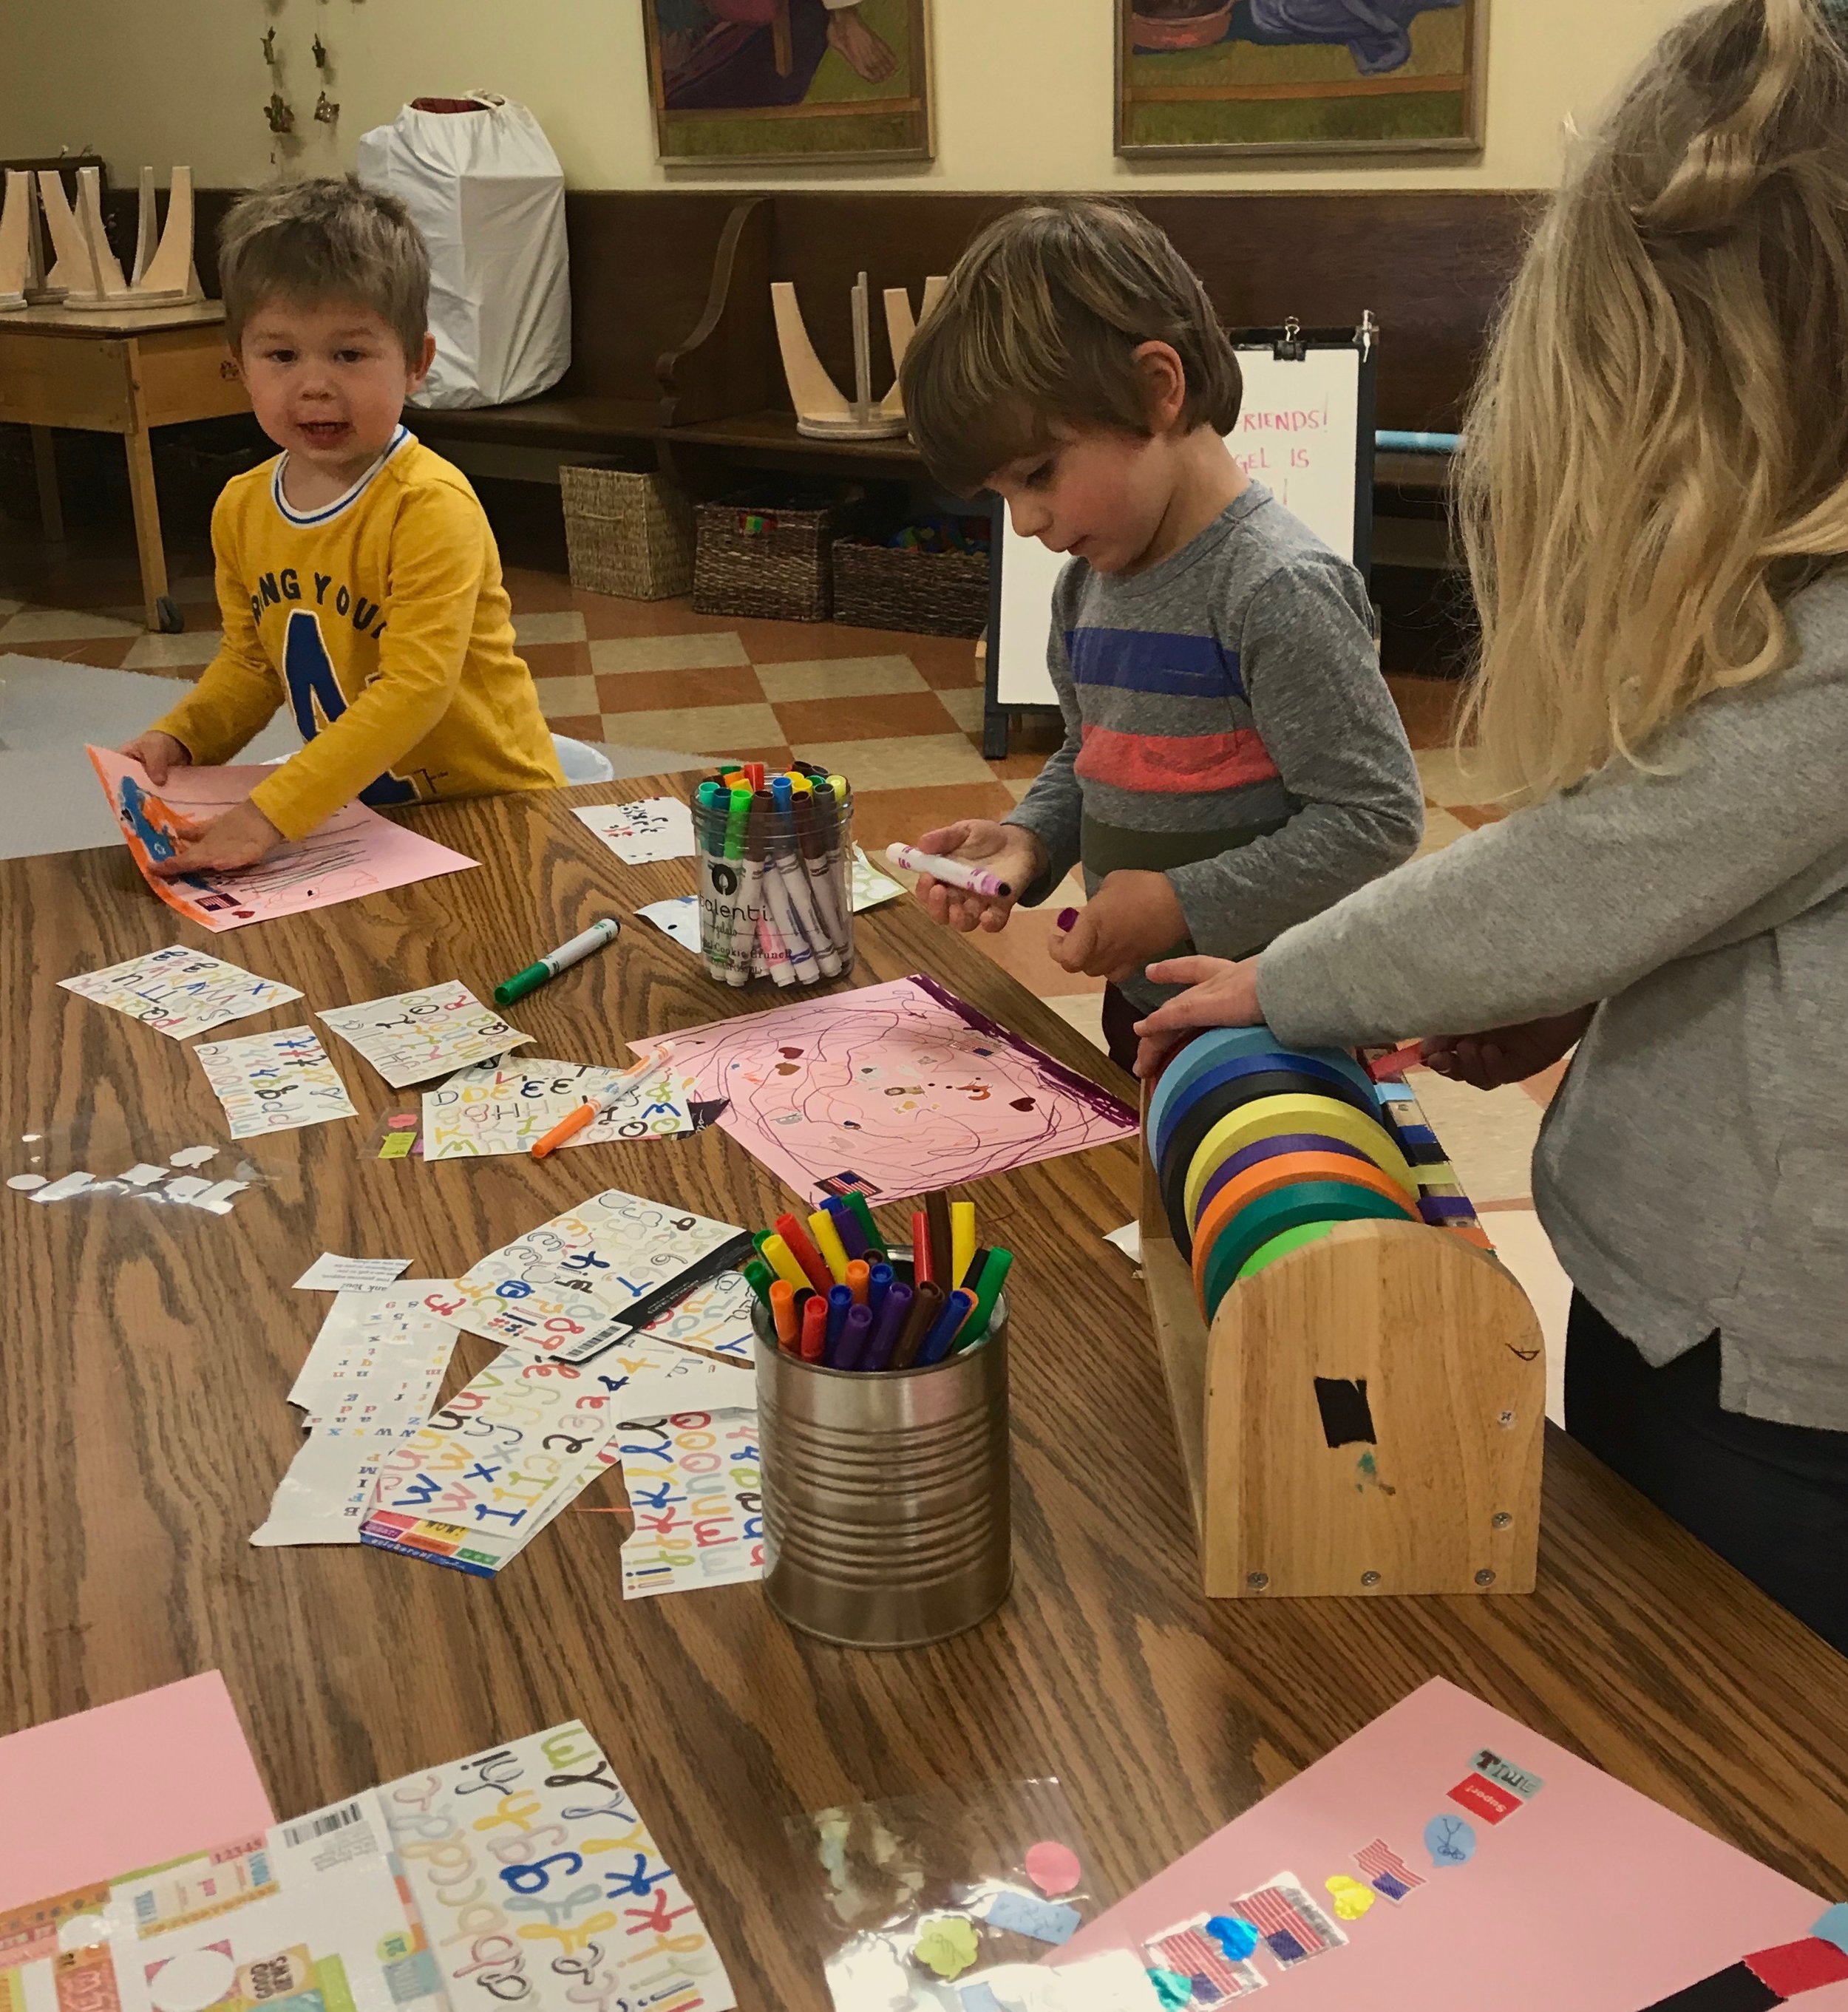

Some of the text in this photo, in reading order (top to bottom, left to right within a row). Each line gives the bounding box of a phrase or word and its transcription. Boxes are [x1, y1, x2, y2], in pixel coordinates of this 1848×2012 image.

[1239, 392, 1328, 433] RIENDS!
[1234, 447, 1309, 473] GEL IS
[251, 568, 302, 627] RING
[715, 942, 749, 959] Cookie
[750, 949, 793, 959] Crunch
[367, 1284, 387, 1294] ank
[1464, 1785, 1507, 1813] Super!
